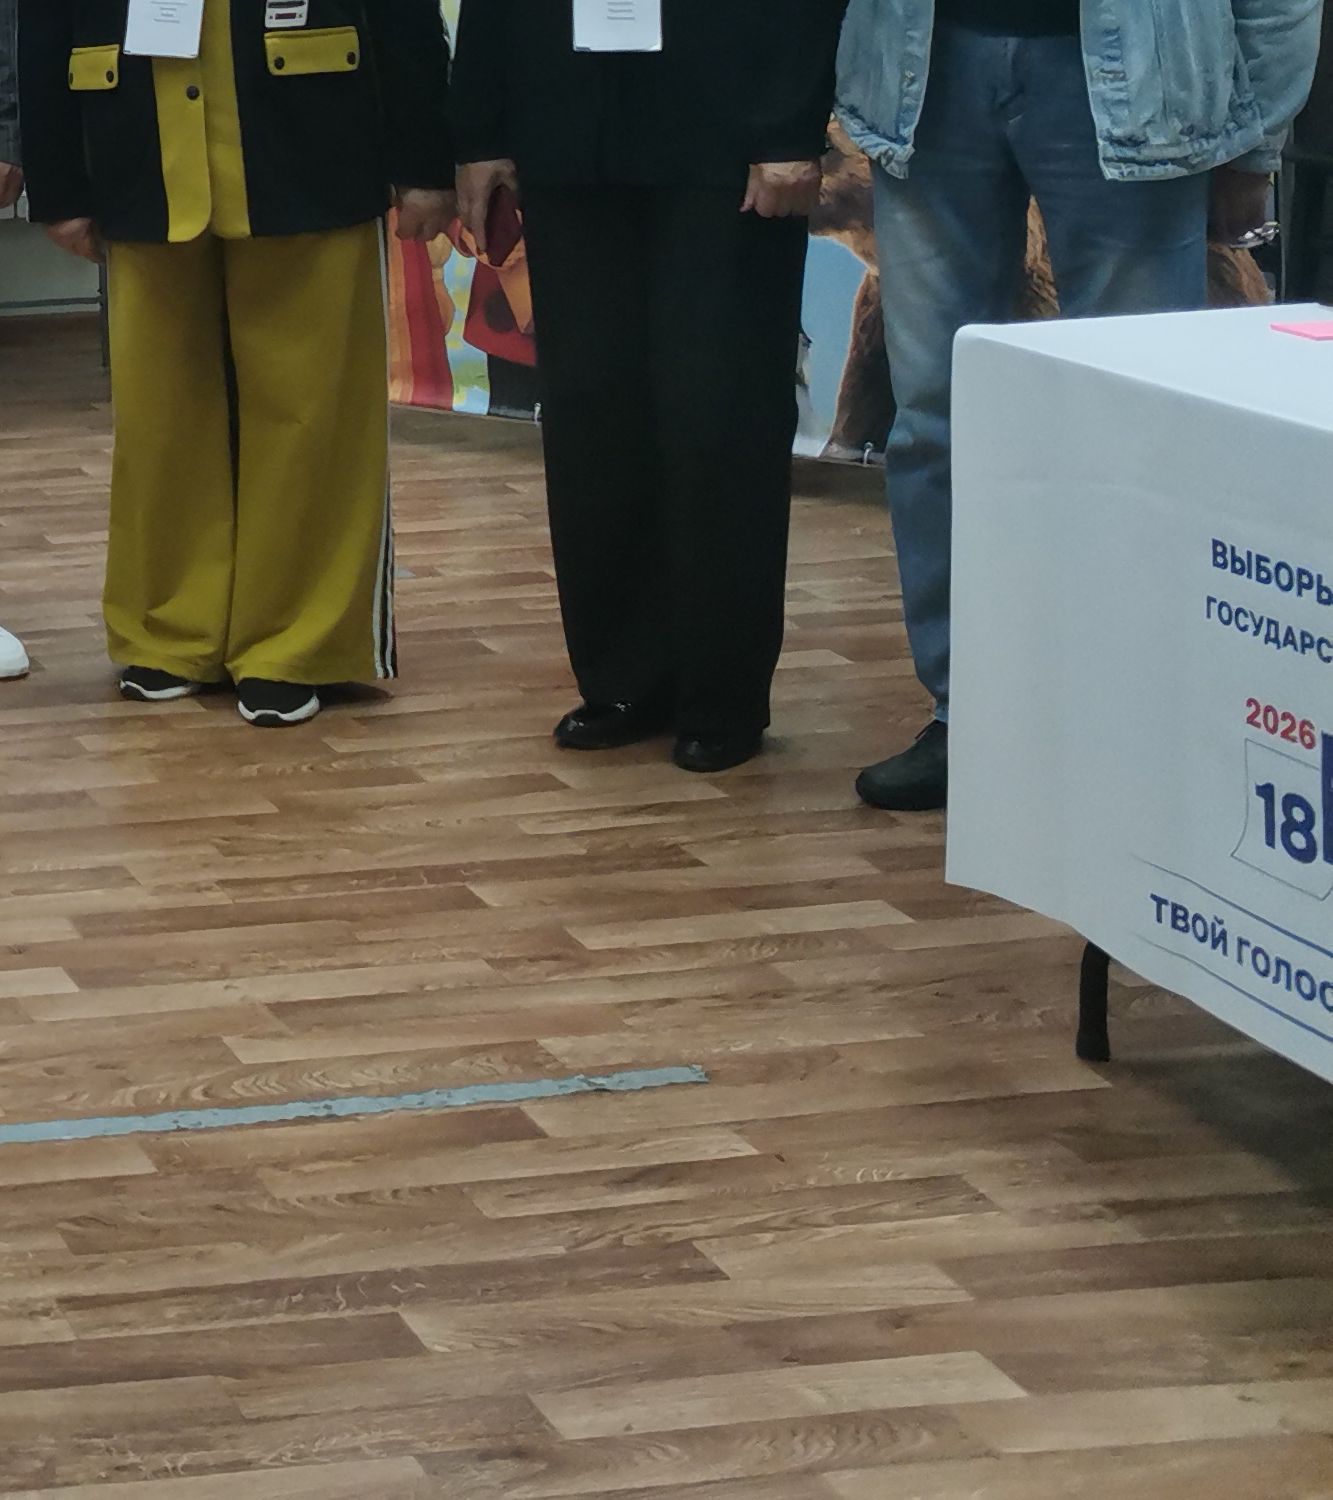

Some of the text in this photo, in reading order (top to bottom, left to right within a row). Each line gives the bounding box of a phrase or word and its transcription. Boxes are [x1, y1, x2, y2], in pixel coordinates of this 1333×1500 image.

[1206, 595, 1333, 664] ГОСУДАРС
[1245, 697, 1317, 750] 2026
[1254, 782, 1318, 865] 18
[1150, 893, 1333, 1013] ТВОЙ ГОЛОС
